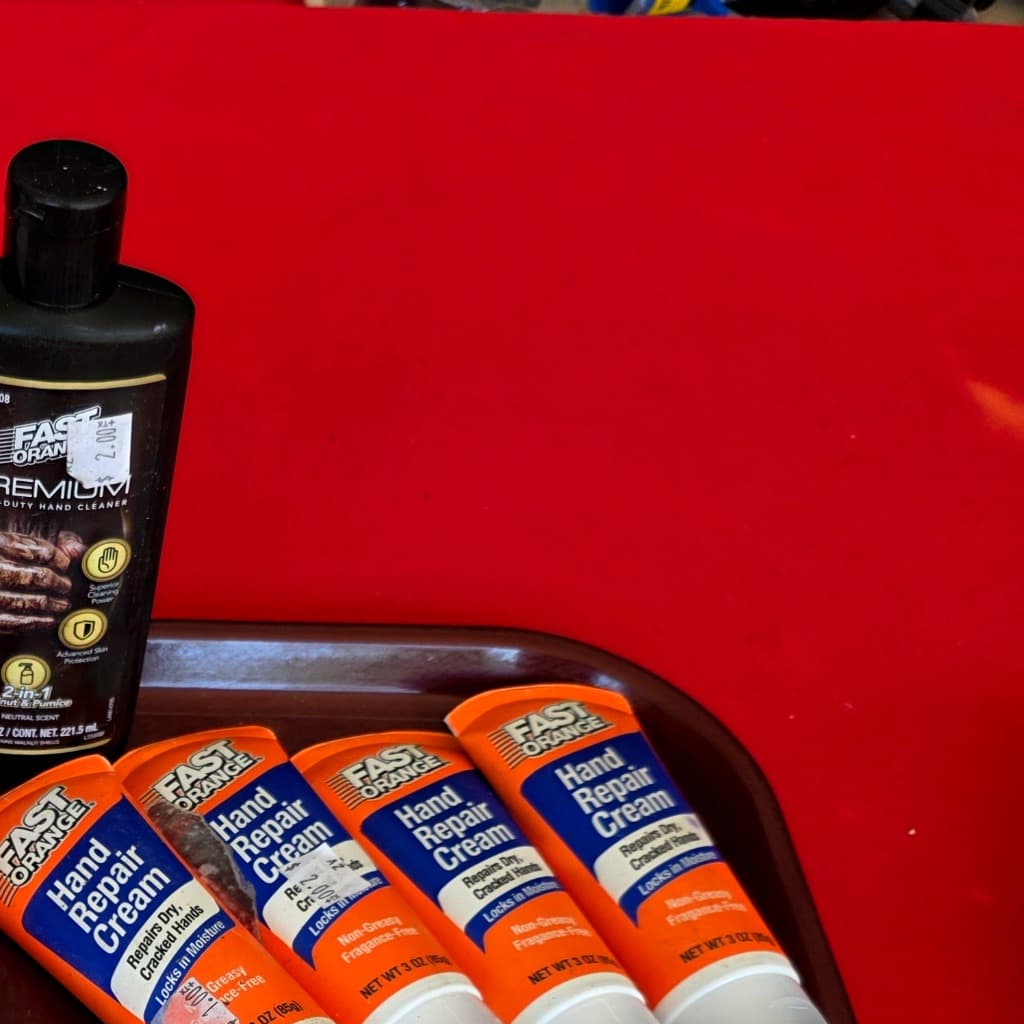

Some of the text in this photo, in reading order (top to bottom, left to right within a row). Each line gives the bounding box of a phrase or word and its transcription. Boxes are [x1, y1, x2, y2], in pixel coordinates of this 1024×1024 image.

[14, 406, 101, 449] FAST
[39, 503, 71, 511] HAND
[77, 500, 128, 511] CLEANER
[1, 712, 34, 720] NEUTRAL
[2, 686, 53, 699] 2-in-1
[20, 699, 28, 707] &
[32, 699, 72, 708] Pumice
[12, 728, 38, 738] CONT.
[40, 729, 58, 738] NET.
[60, 725, 84, 737] 221.5
[503, 701, 590, 744] FAST
[521, 714, 608, 759] ORANGE
[152, 738, 243, 803] FAST
[174, 752, 256, 812] ORANGE
[339, 744, 427, 789] FAST
[359, 753, 444, 801] ORANGE
[554, 747, 624, 790] Hand
[572, 765, 656, 815] Repair
[210, 786, 277, 842] Hand
[229, 799, 311, 863] Repair
[394, 786, 463, 829] Hand
[412, 801, 494, 850] Repair
[591, 789, 675, 838] Cream
[8, 798, 92, 888] ORANGE
[252, 820, 334, 885] Cream
[432, 824, 516, 871] Cream
[46, 838, 111, 912] Hand
[68, 844, 145, 934] Repair
[637, 870, 671, 896] Locks
[93, 867, 171, 955] Cream
[126, 903, 184, 970] Repairs Dry,
[140, 904, 204, 982] Cracked Hands
[185, 920, 226, 960] Moisture
